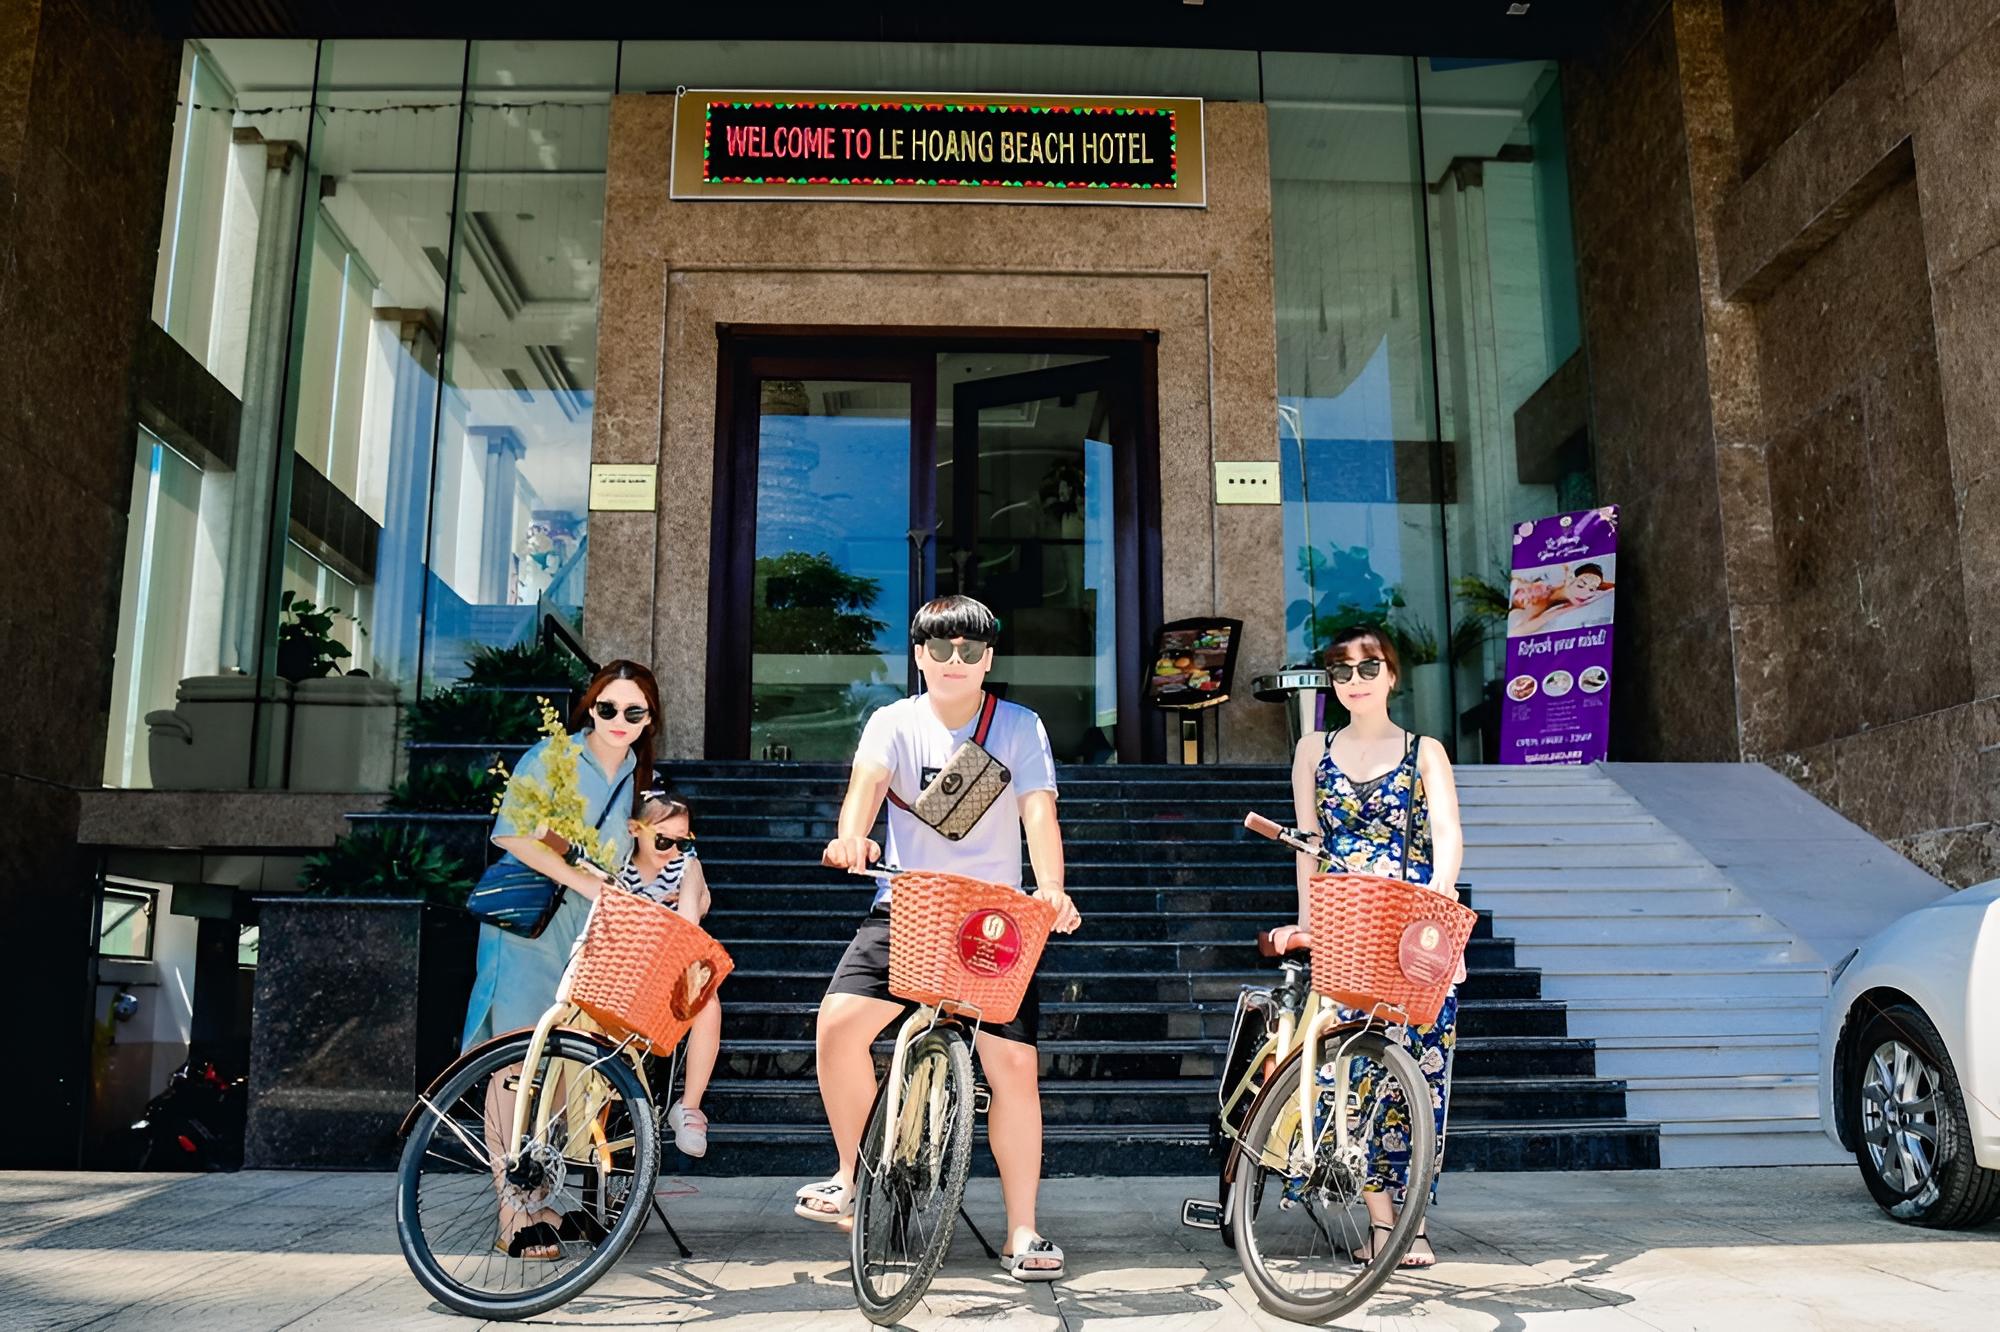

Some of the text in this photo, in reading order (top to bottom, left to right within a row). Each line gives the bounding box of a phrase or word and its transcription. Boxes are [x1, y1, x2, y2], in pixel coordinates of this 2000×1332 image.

[726, 125, 1154, 164] WELCOME TO LE HOANG BEACH HOTEL
